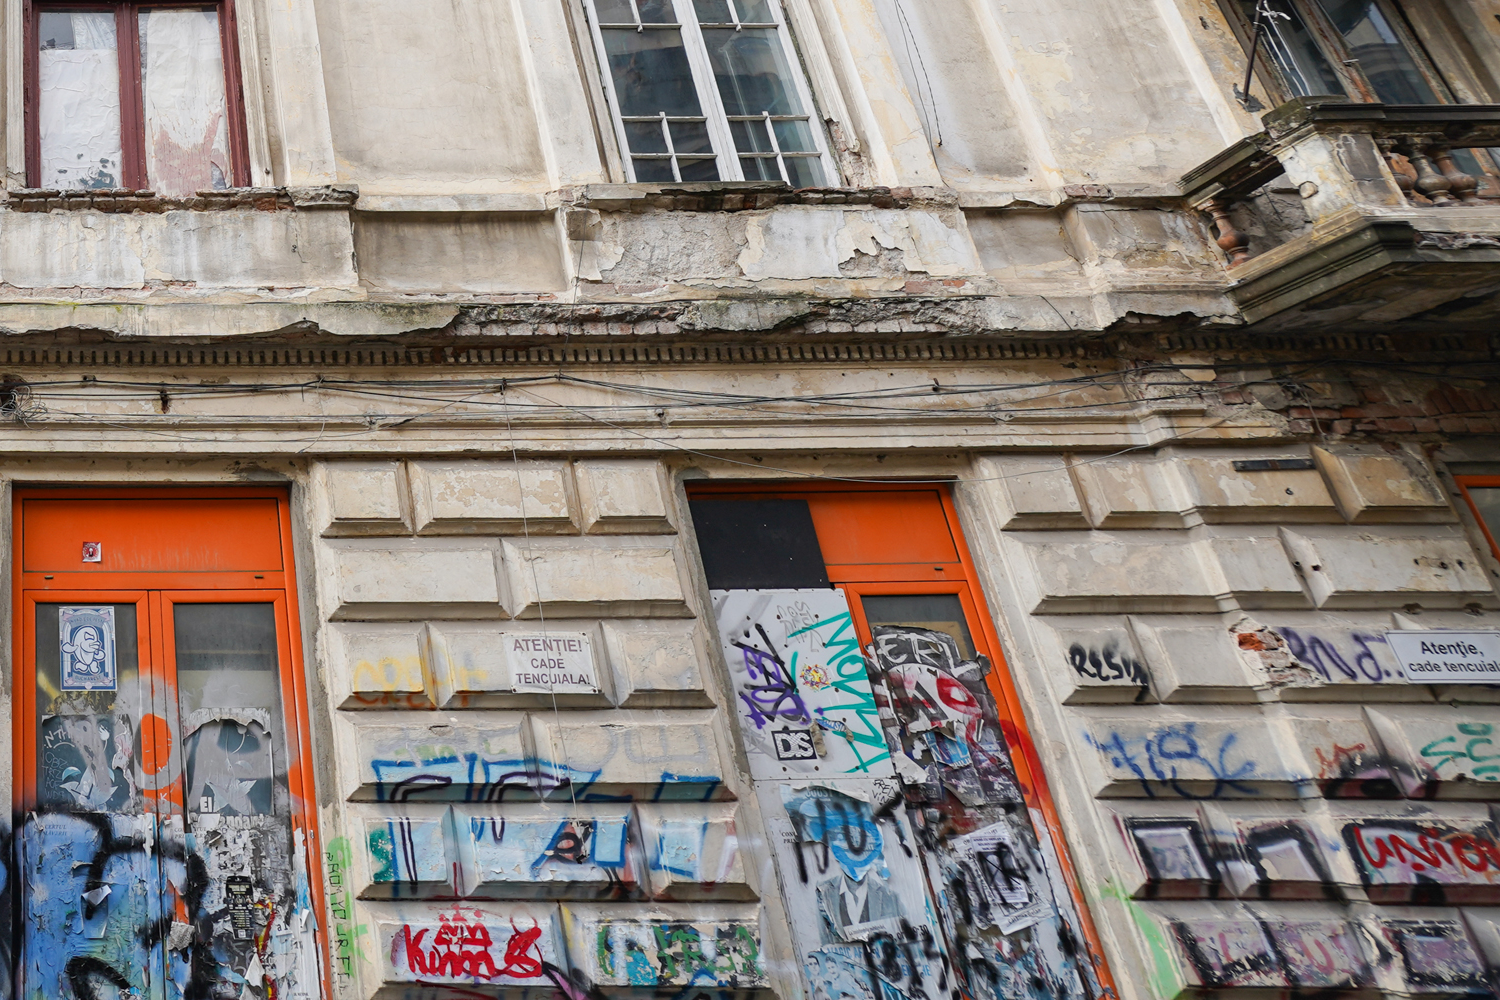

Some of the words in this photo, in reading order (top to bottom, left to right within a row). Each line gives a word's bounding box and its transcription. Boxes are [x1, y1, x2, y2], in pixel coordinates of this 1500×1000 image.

[512, 638, 582, 657] ATENȚIE!
[530, 658, 565, 670] CADE
[1408, 661, 1442, 673] cade
[1442, 660, 1500, 673] tencuial
[515, 672, 591, 686] TENCUIALA!
